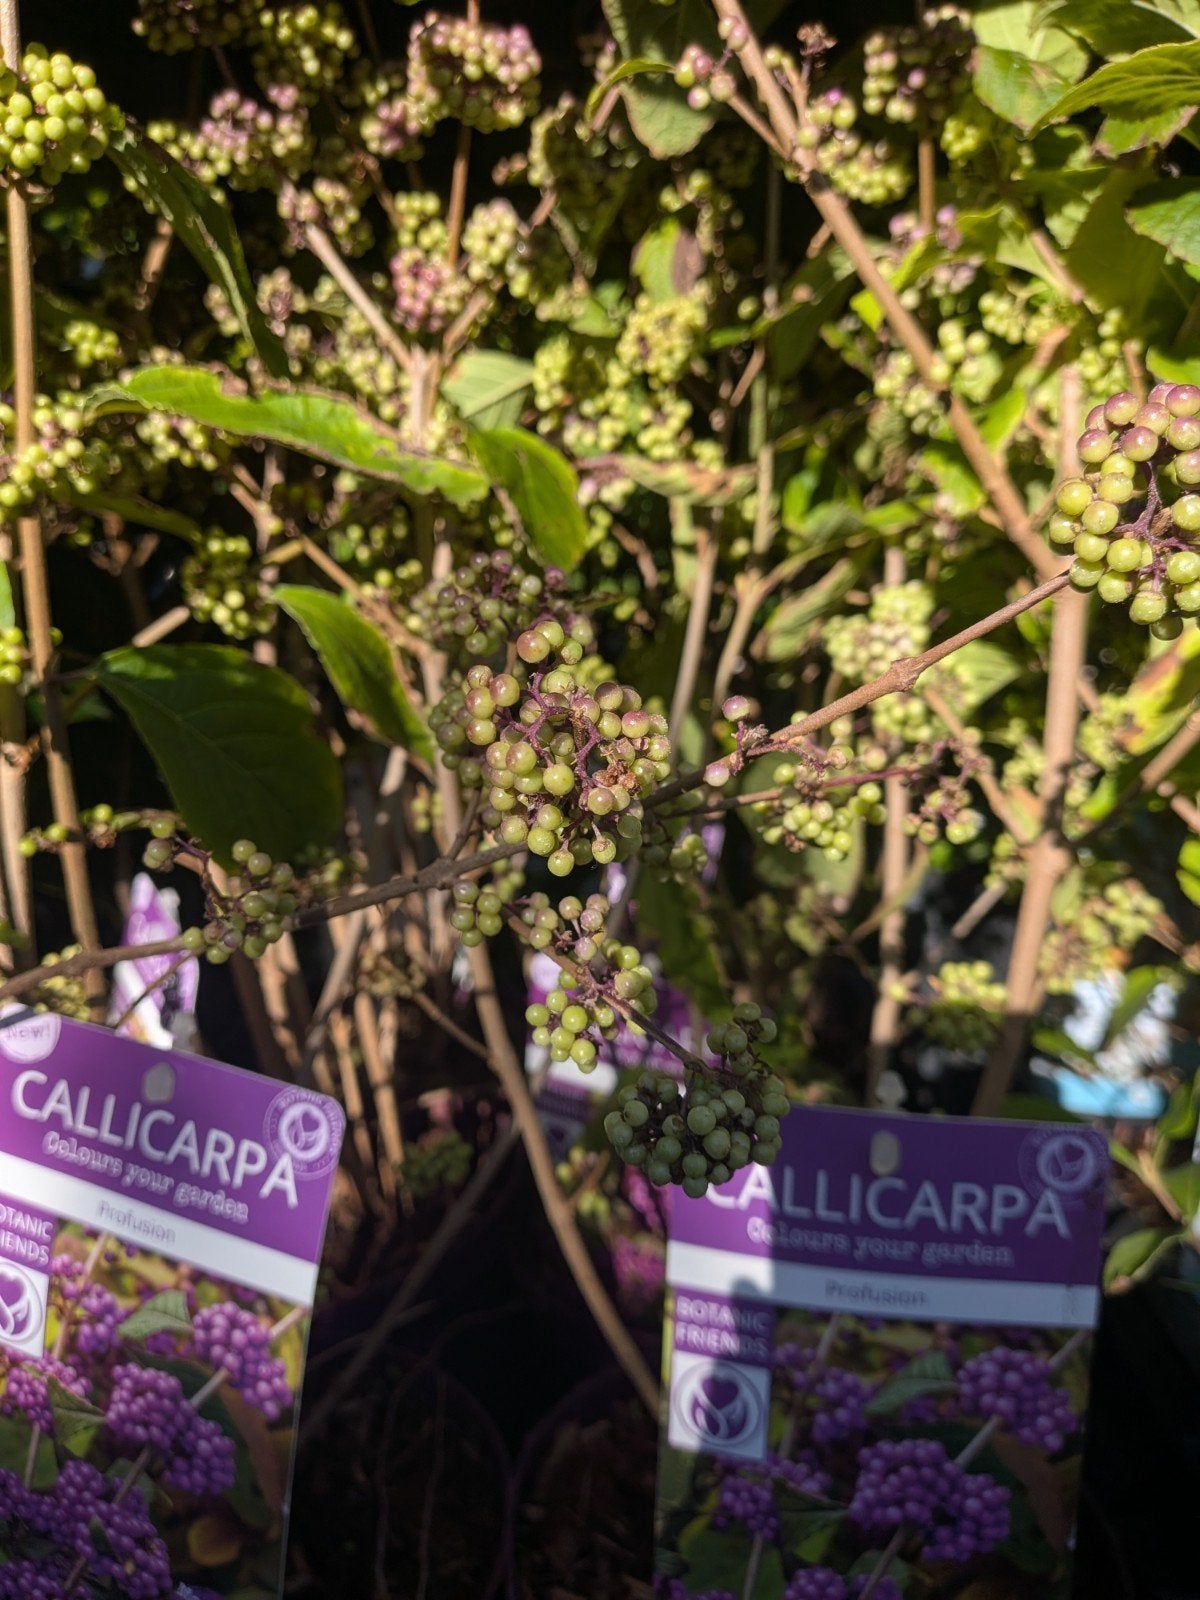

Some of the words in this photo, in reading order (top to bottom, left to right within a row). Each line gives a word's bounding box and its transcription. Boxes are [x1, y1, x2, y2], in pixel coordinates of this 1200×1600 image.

[11, 1070, 299, 1209] CALLICARPA
[42, 1131, 123, 1177] Colours
[121, 1163, 174, 1195] your
[173, 1182, 249, 1225] garden
[97, 1199, 176, 1246] Profusion
[747, 1216, 850, 1254] Colours
[853, 1234, 919, 1263] your
[921, 1238, 1015, 1269] garden
[676, 1295, 771, 1336] BOTANIC
[824, 1278, 931, 1308] Profusion
[675, 1321, 769, 1362] FRIENDS
